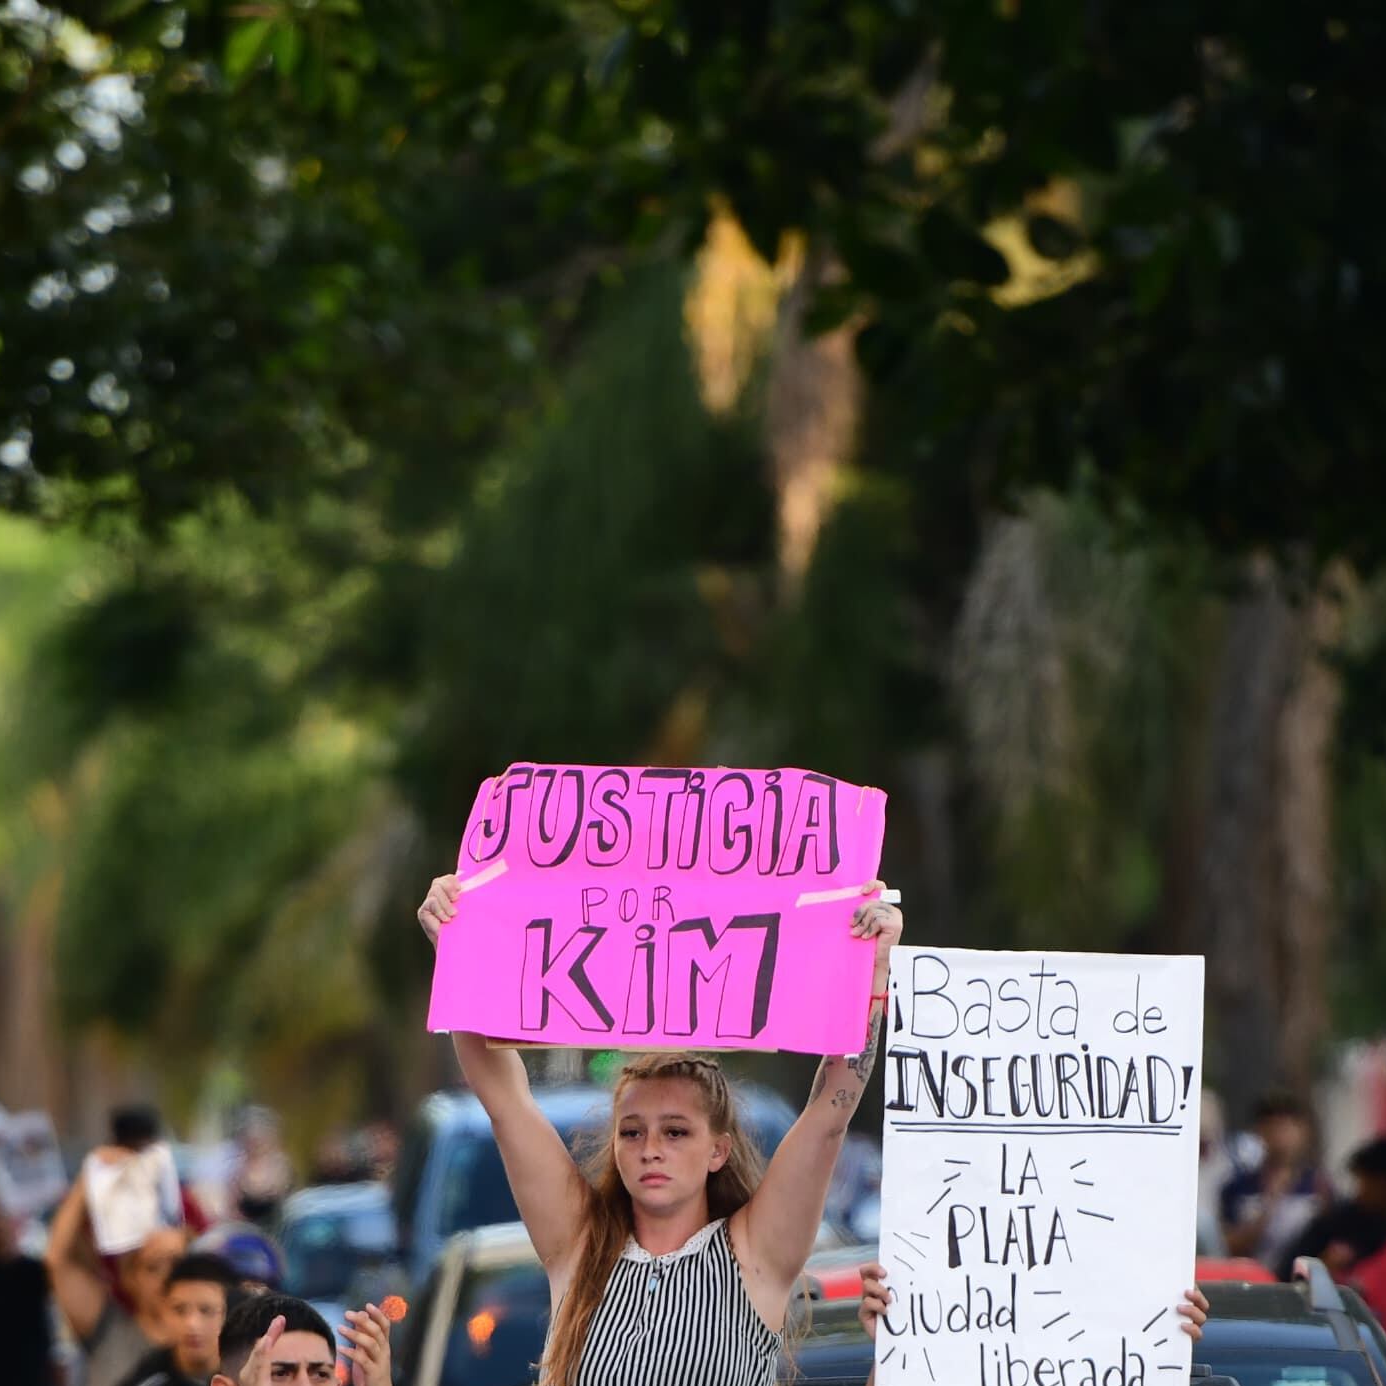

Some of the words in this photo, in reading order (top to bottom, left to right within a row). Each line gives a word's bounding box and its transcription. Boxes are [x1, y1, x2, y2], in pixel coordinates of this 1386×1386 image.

[581, 885, 675, 924] POR
[1112, 975, 1168, 1035] de
[1000, 1143, 1044, 1196] LA
[946, 1204, 1073, 1270] PLATA
